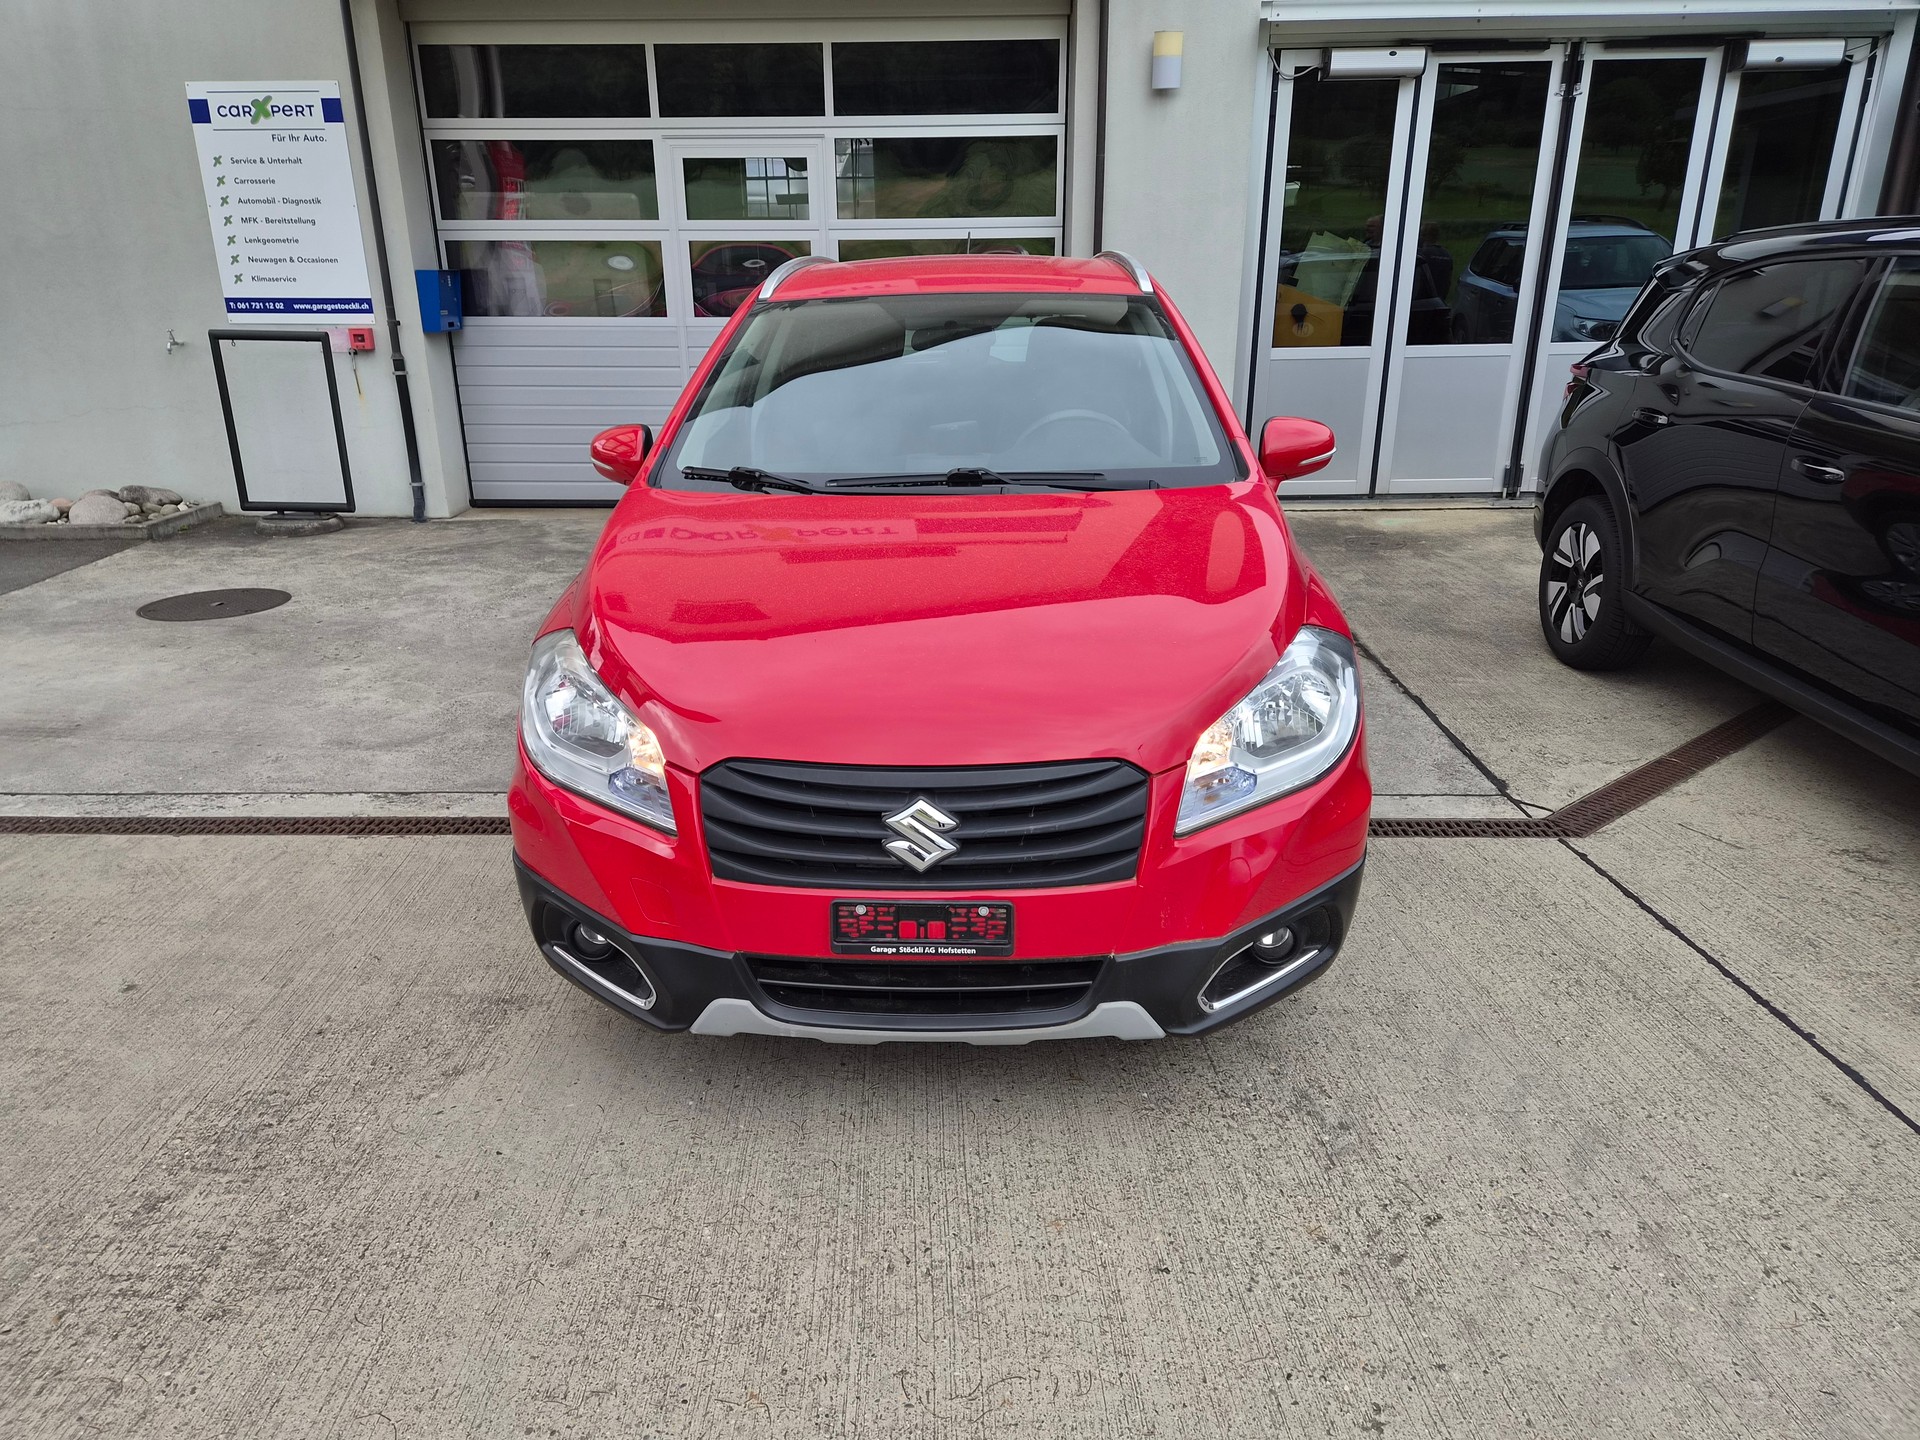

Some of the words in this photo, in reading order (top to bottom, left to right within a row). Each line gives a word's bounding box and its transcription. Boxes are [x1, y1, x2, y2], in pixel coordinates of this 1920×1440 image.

[271, 134, 285, 142] Für
[288, 134, 300, 142] Ihr
[303, 134, 327, 142] Auto.
[234, 177, 276, 185] Carrosserie
[237, 197, 276, 205] Automobil
[282, 197, 321, 206] Diagnostik
[265, 217, 316, 226] Bereitstellung
[244, 237, 299, 245] Lenkgeometrie
[248, 256, 287, 265] Neuwagen
[297, 256, 338, 264] Occasionen
[251, 275, 296, 283] Klimaservice
[293, 302, 369, 311] www.garagestoeckli.ch
[871, 946, 896, 954] Garage
